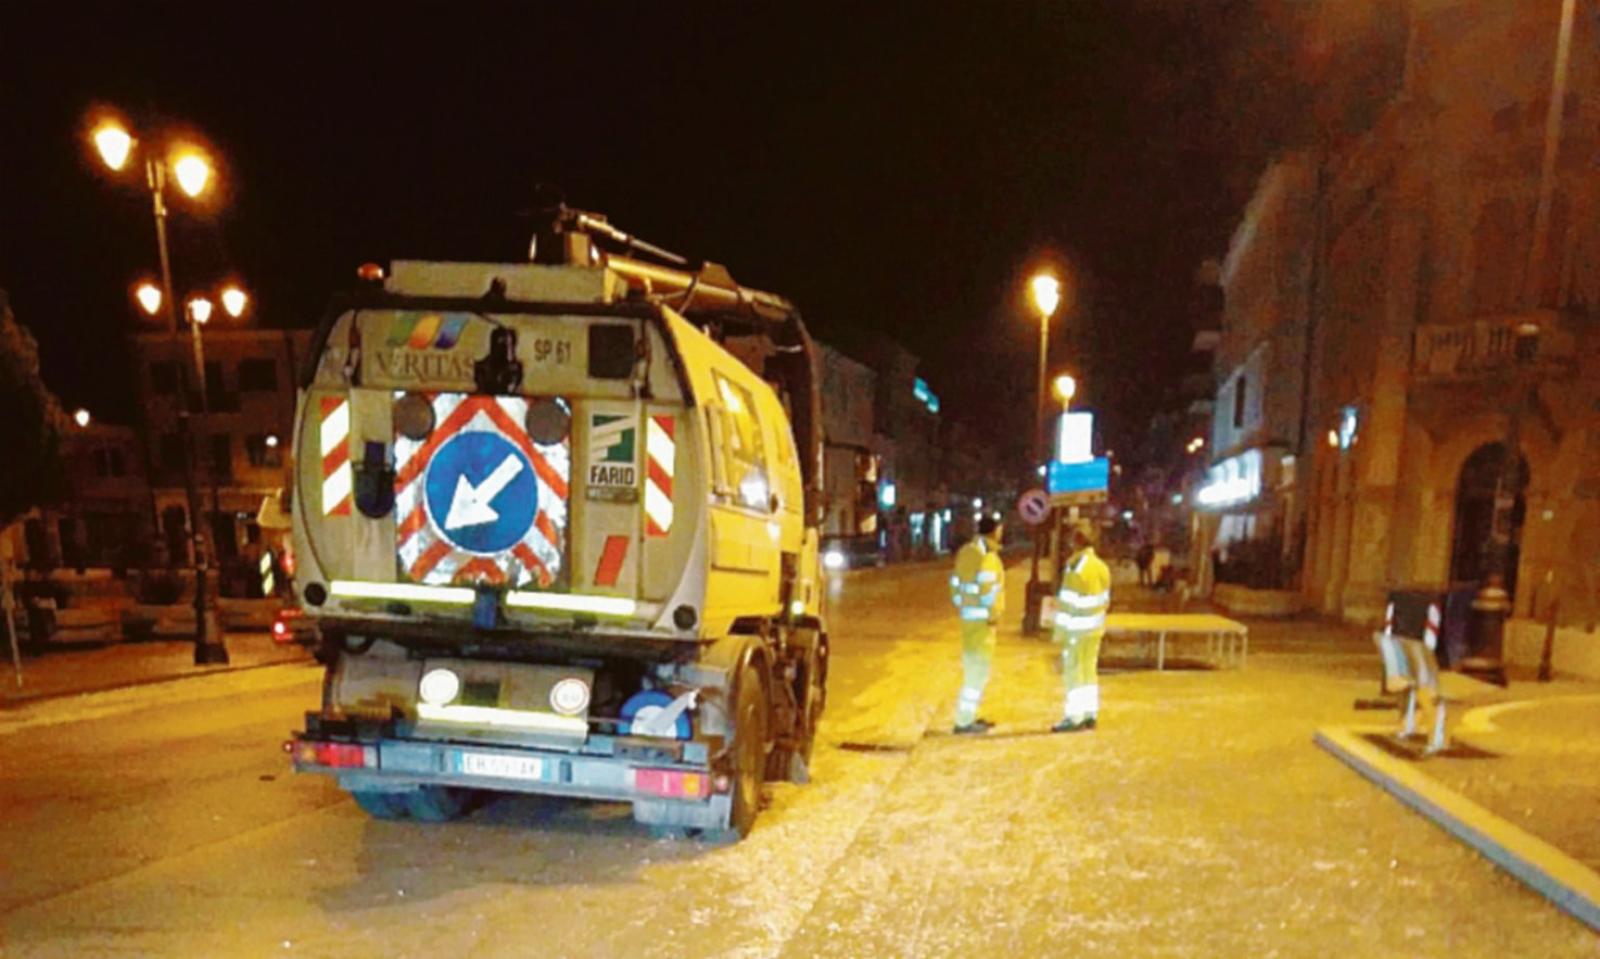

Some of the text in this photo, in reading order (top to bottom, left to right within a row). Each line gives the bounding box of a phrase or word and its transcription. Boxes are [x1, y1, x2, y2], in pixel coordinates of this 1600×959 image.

[534, 338, 572, 363] SP 61
[590, 465, 635, 485] FARID
